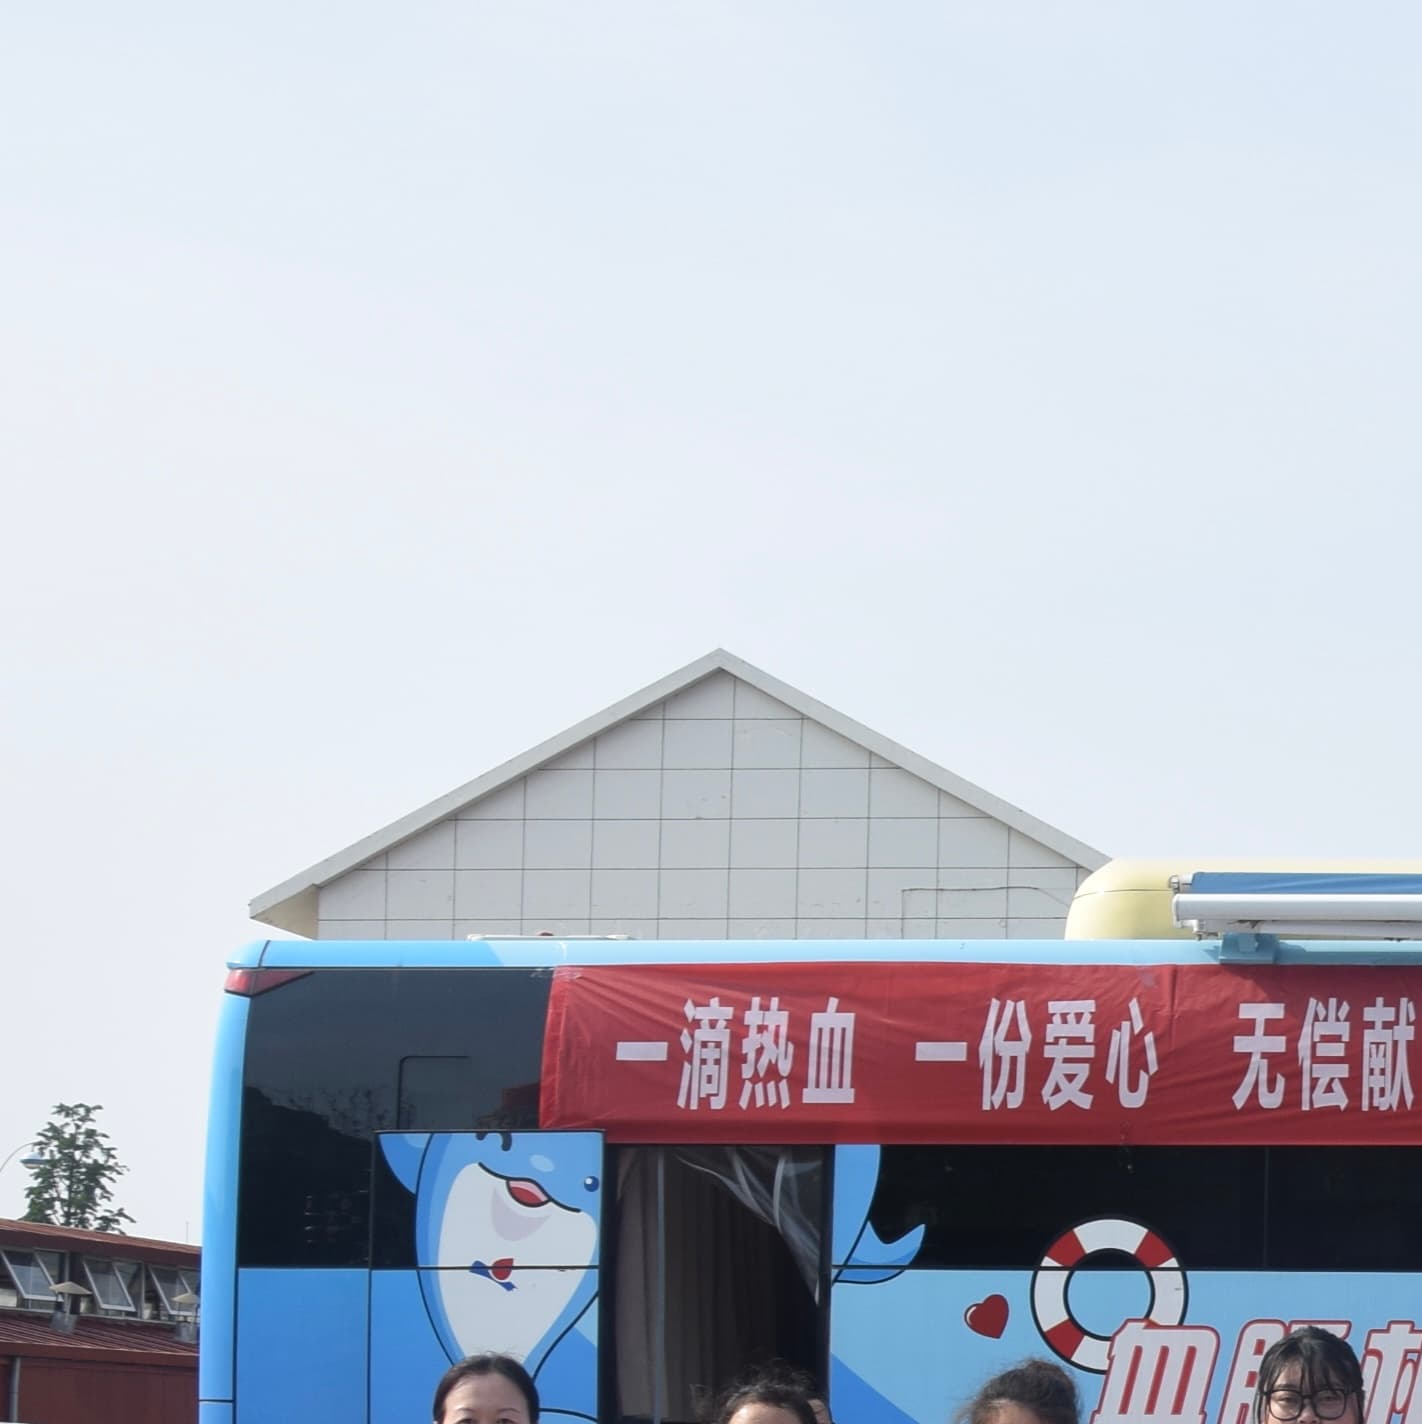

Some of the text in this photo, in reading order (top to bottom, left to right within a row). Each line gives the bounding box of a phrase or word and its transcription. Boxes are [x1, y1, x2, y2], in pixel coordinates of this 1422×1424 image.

[616, 996, 856, 1110] 一滴热血
[915, 996, 1159, 1110] 一份爱心
